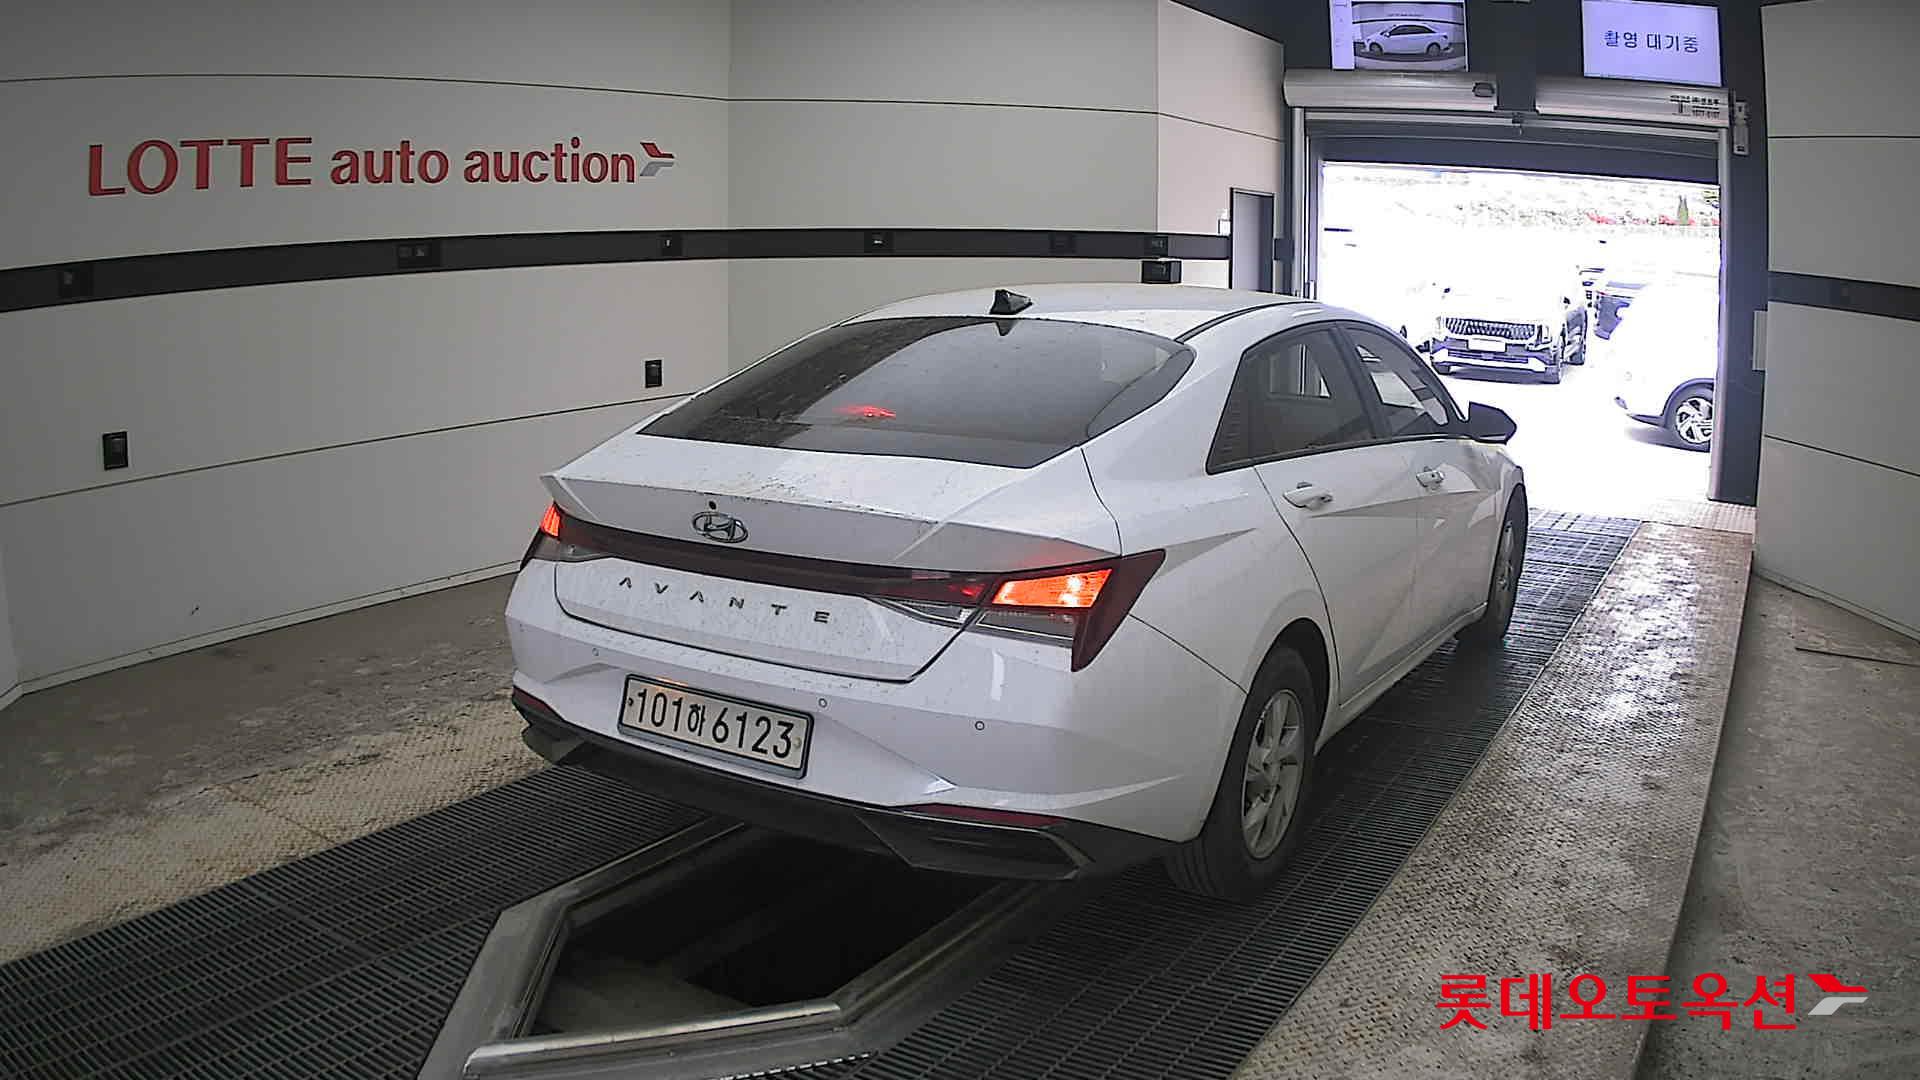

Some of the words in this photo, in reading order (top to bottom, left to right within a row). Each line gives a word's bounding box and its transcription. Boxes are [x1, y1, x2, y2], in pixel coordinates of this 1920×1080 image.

[1604, 30, 1638, 49] 촬영
[1646, 33, 1699, 53] 대기중
[88, 137, 312, 196] LOTTE
[330, 140, 449, 185] auto
[463, 137, 636, 183] auction
[619, 576, 830, 623] AVANTE
